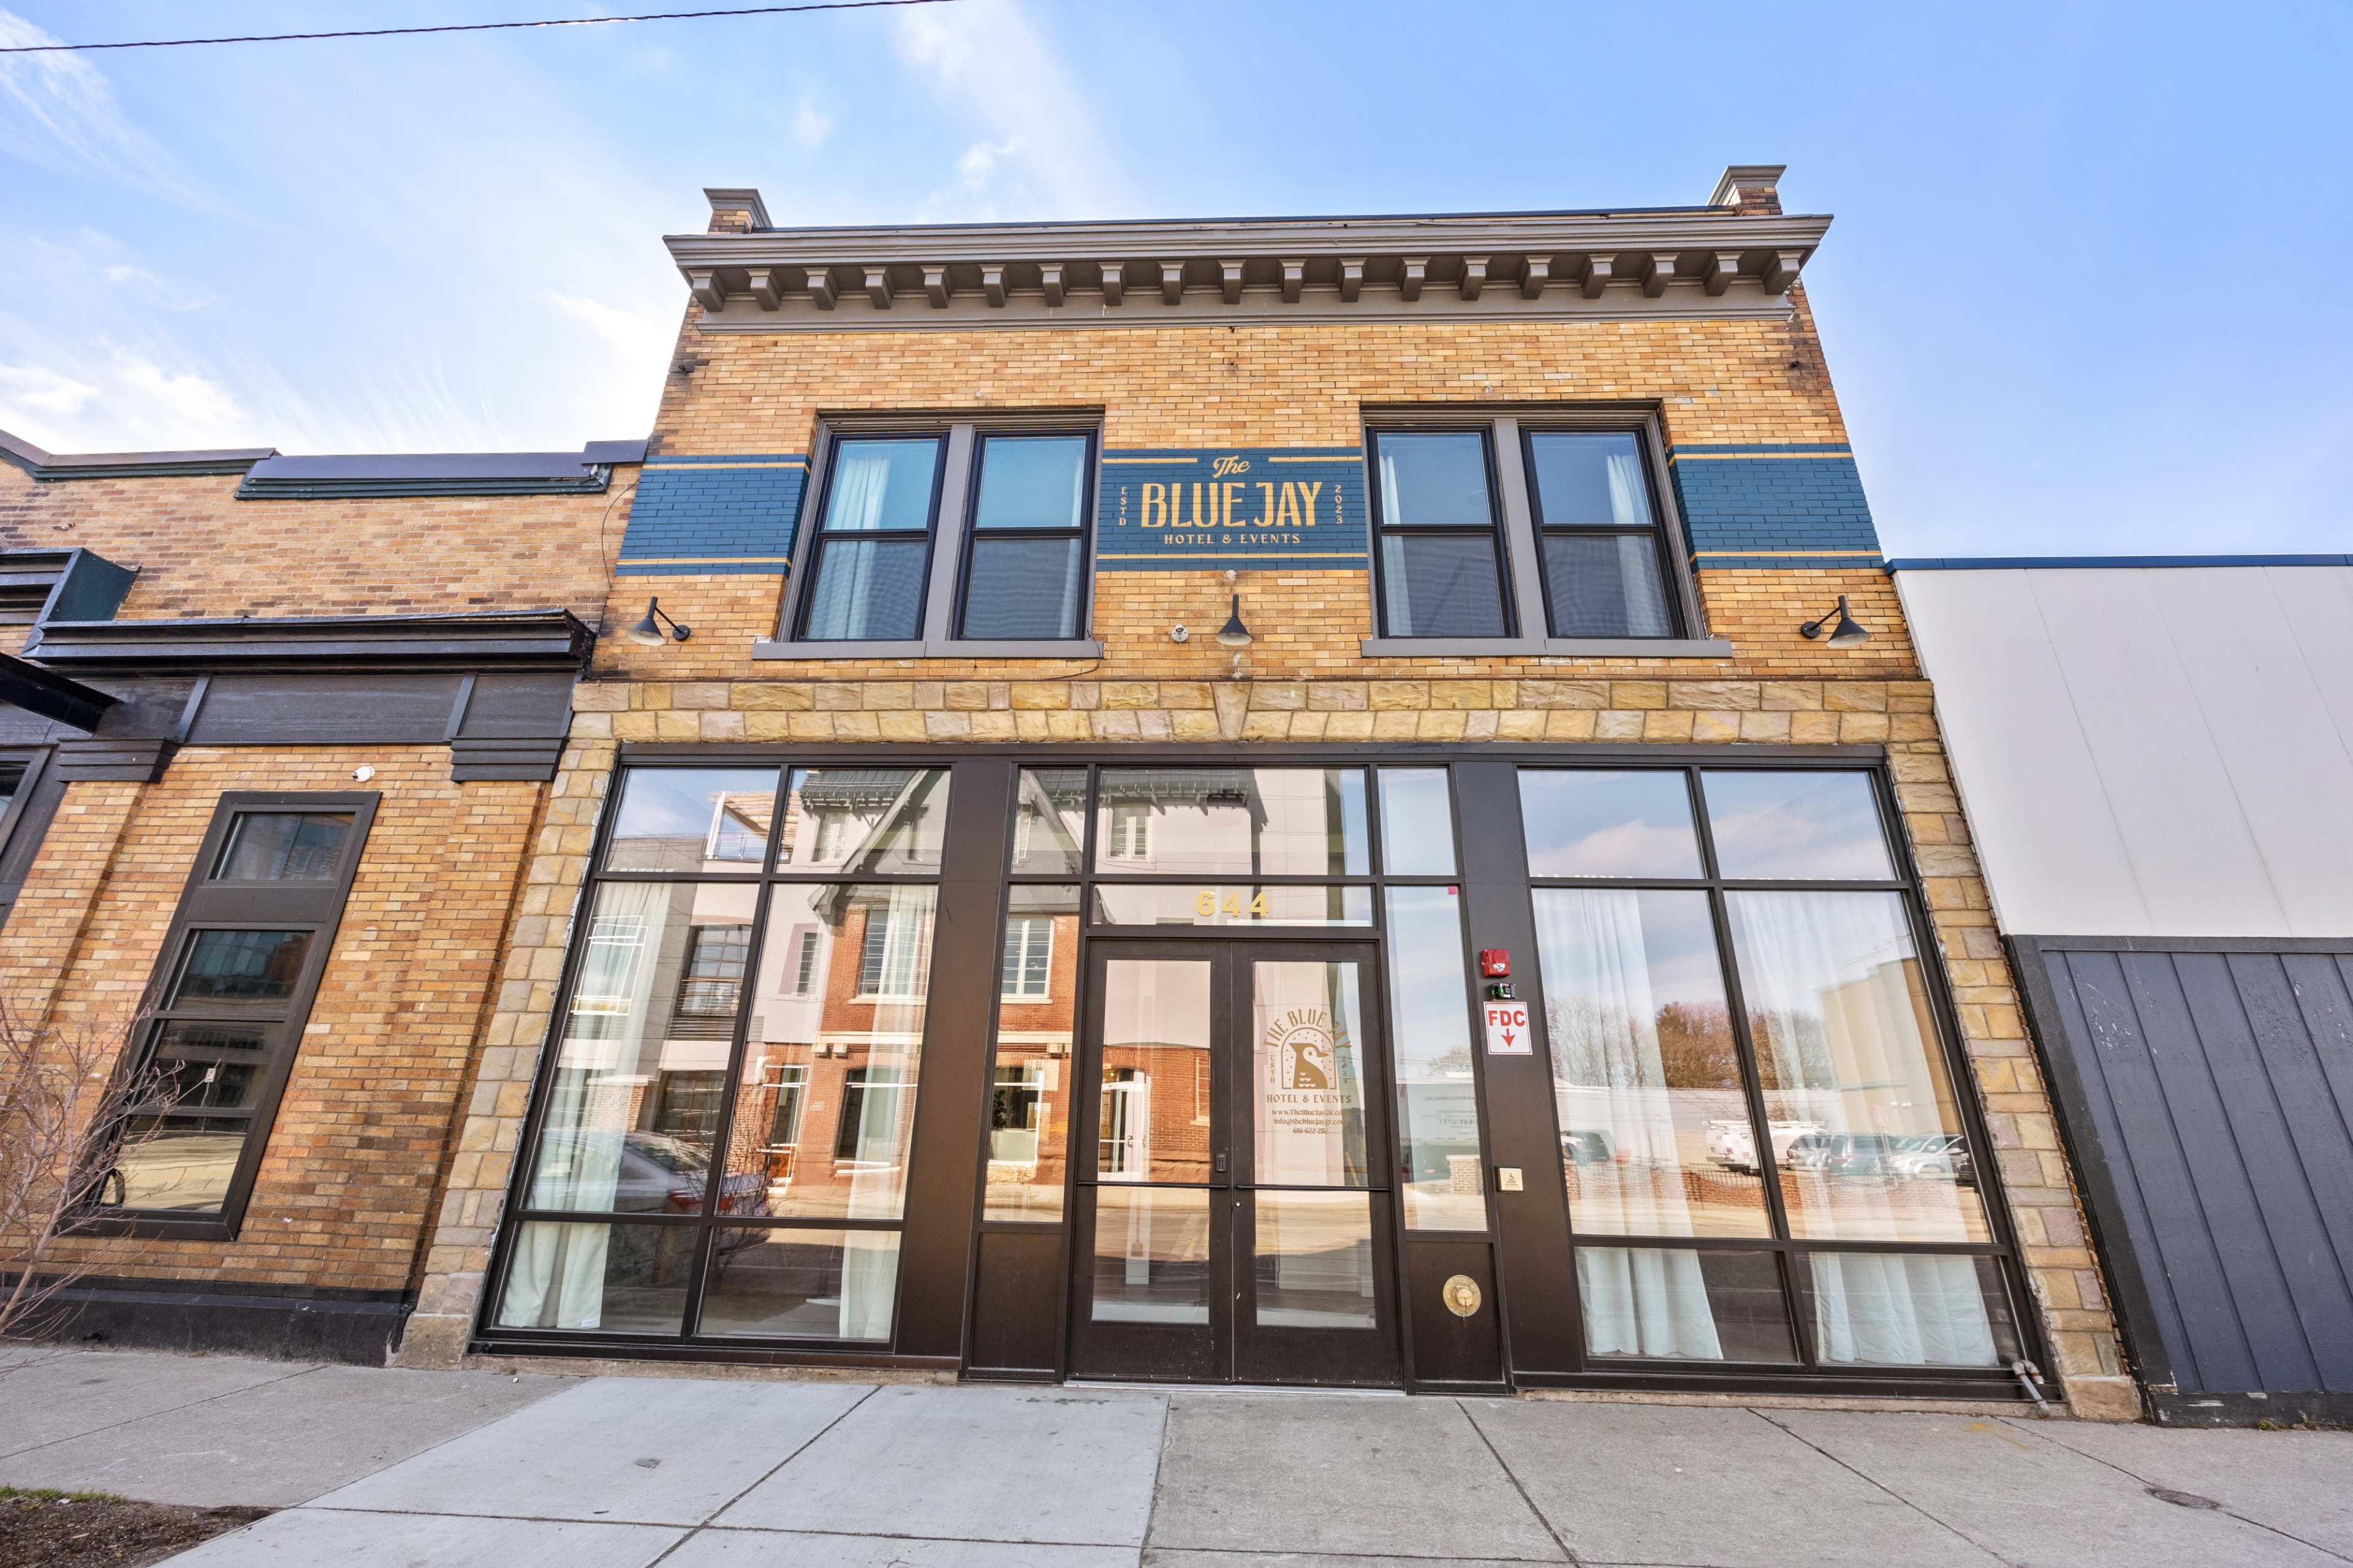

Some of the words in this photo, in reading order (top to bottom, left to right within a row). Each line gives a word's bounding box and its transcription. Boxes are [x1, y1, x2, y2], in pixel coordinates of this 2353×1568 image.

[1212, 455, 1250, 479] The
[1141, 482, 1246, 528] BLUE
[1254, 482, 1322, 527] JAY
[1335, 485, 1343, 524] 2023
[1164, 534, 1213, 544] HOTEL
[1222, 534, 1232, 543] &
[1240, 534, 1300, 543] EVENTS
[1196, 891, 1269, 918] 644
[1264, 1019, 1289, 1047] THE
[1287, 1009, 1327, 1028] BLUE
[1327, 1021, 1352, 1048] JAY
[1488, 1010, 1525, 1026] FDC
[1266, 1094, 1298, 1103] HOTEL
[1302, 1094, 1309, 1103] &
[1313, 1094, 1352, 1103] EVENTS
